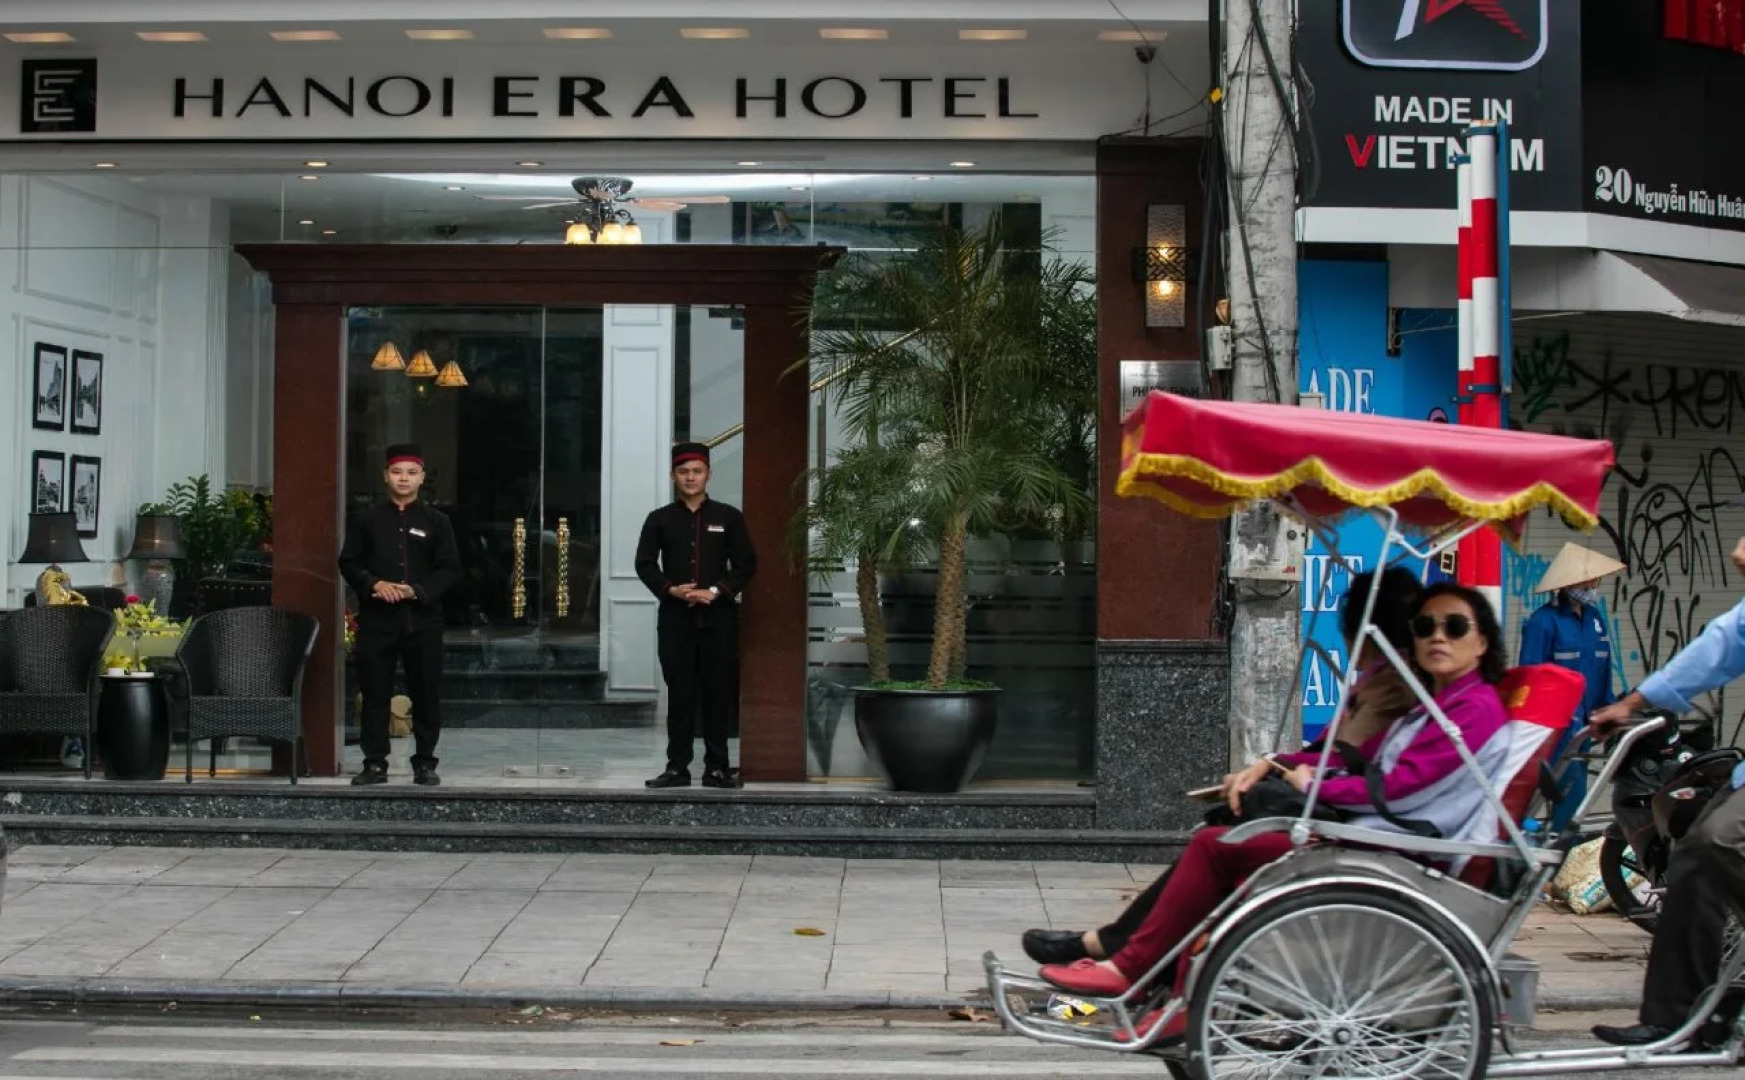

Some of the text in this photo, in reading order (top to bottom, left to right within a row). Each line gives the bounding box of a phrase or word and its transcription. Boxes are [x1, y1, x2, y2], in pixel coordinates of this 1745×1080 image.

[173, 74, 1039, 119] HANOI ERA HOTEL
[1375, 96, 1512, 125] MADE IN
[1345, 134, 1544, 172] VIETNM
[1595, 165, 1633, 204] 20
[1635, 183, 1686, 214] Nguyễn
